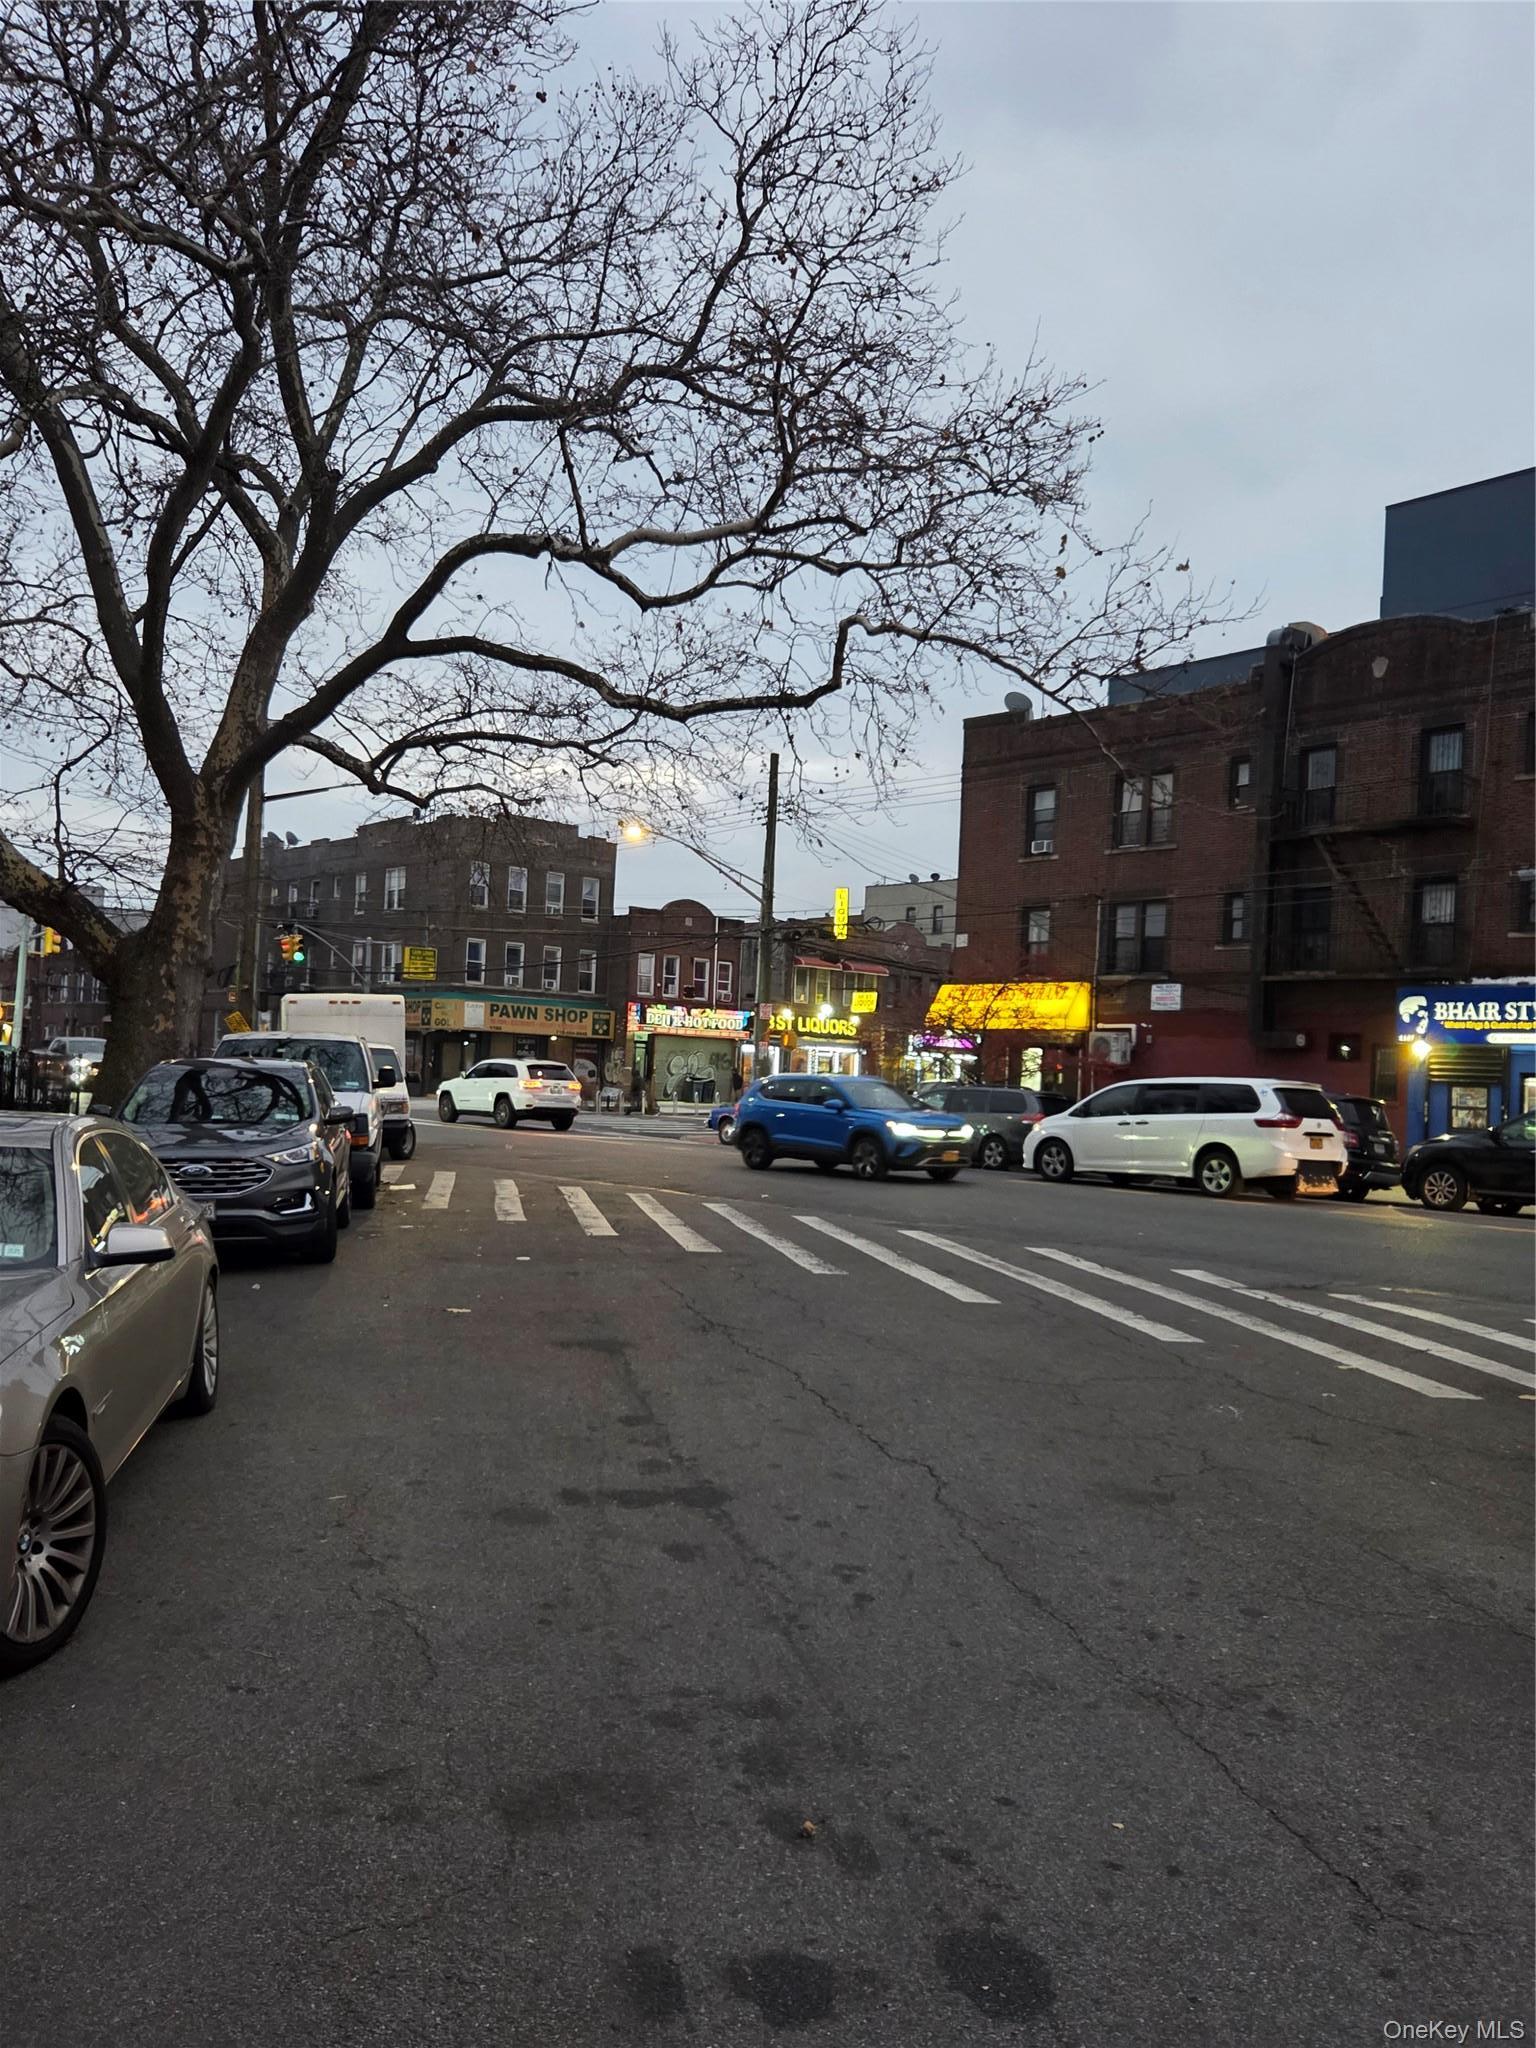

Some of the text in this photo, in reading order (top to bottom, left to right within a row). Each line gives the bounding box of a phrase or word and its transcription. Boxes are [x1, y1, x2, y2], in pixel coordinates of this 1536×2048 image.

[490, 1003, 538, 1020] PAWN
[544, 1007, 589, 1023] SHOP
[1434, 1001, 1502, 1020] BHAIR
[686, 1016, 711, 1029] HOT
[711, 1018, 744, 1030] FOOD
[797, 1016, 857, 1036] LIQUORS
